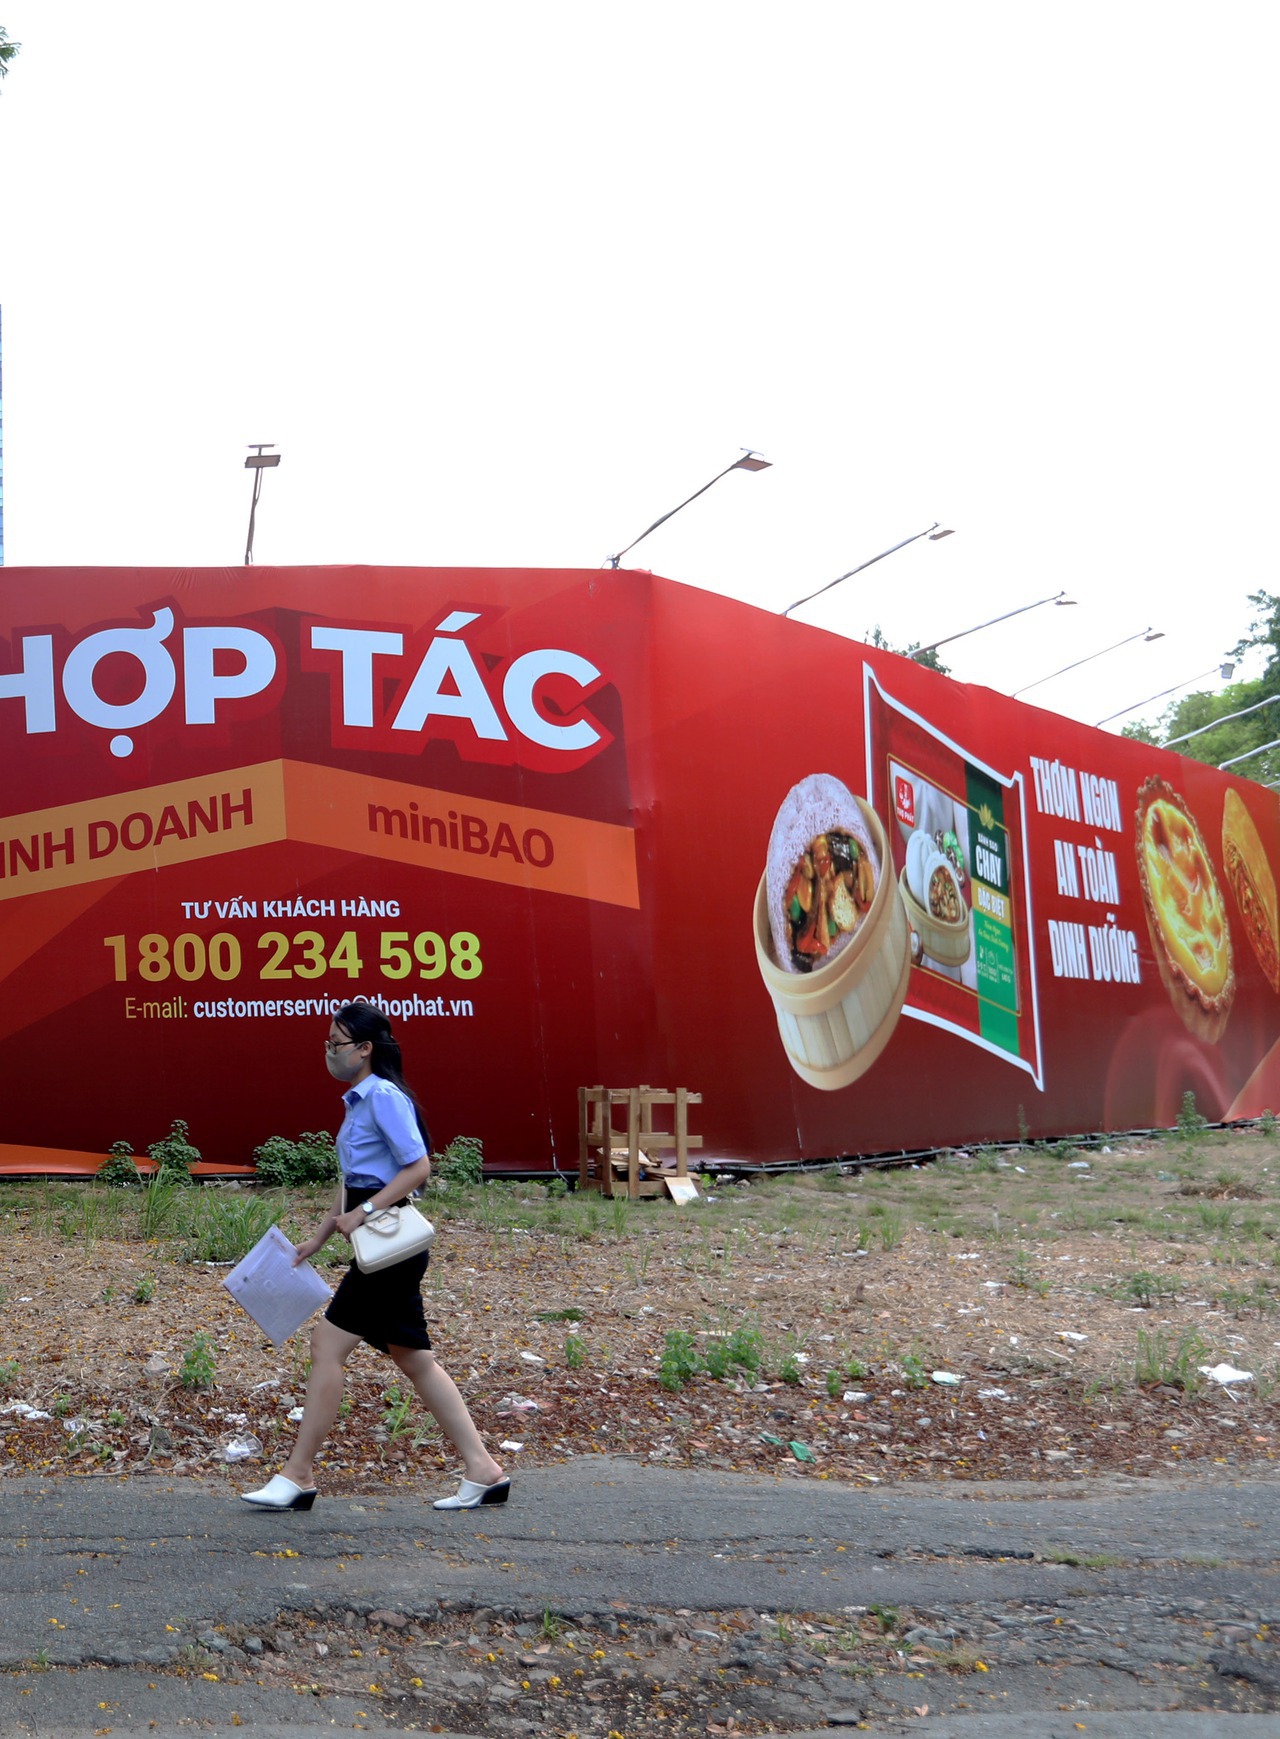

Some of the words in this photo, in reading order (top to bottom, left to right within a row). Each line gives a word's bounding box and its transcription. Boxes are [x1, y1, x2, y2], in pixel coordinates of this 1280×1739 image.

[310, 610, 602, 751] TÁC
[87, 788, 254, 862] DOANH
[367, 802, 555, 868] miniBAO
[1029, 755, 1081, 822] THƠM
[1079, 771, 1122, 833] NGON
[975, 844, 1001, 887] CHAY
[1053, 839, 1079, 898] AN
[1077, 835, 1120, 905] TOÀN
[181, 901, 211, 919] TƯ
[215, 894, 257, 919] VẤN
[263, 896, 335, 917] KHÁCH
[341, 896, 400, 917] HÀNG
[103, 932, 242, 982] 1800
[257, 930, 363, 980] 234
[379, 931, 483, 980] 598
[1047, 919, 1090, 979] DINH
[1088, 912, 1141, 984] DƯỠNG
[125, 996, 188, 1019] E-mail:
